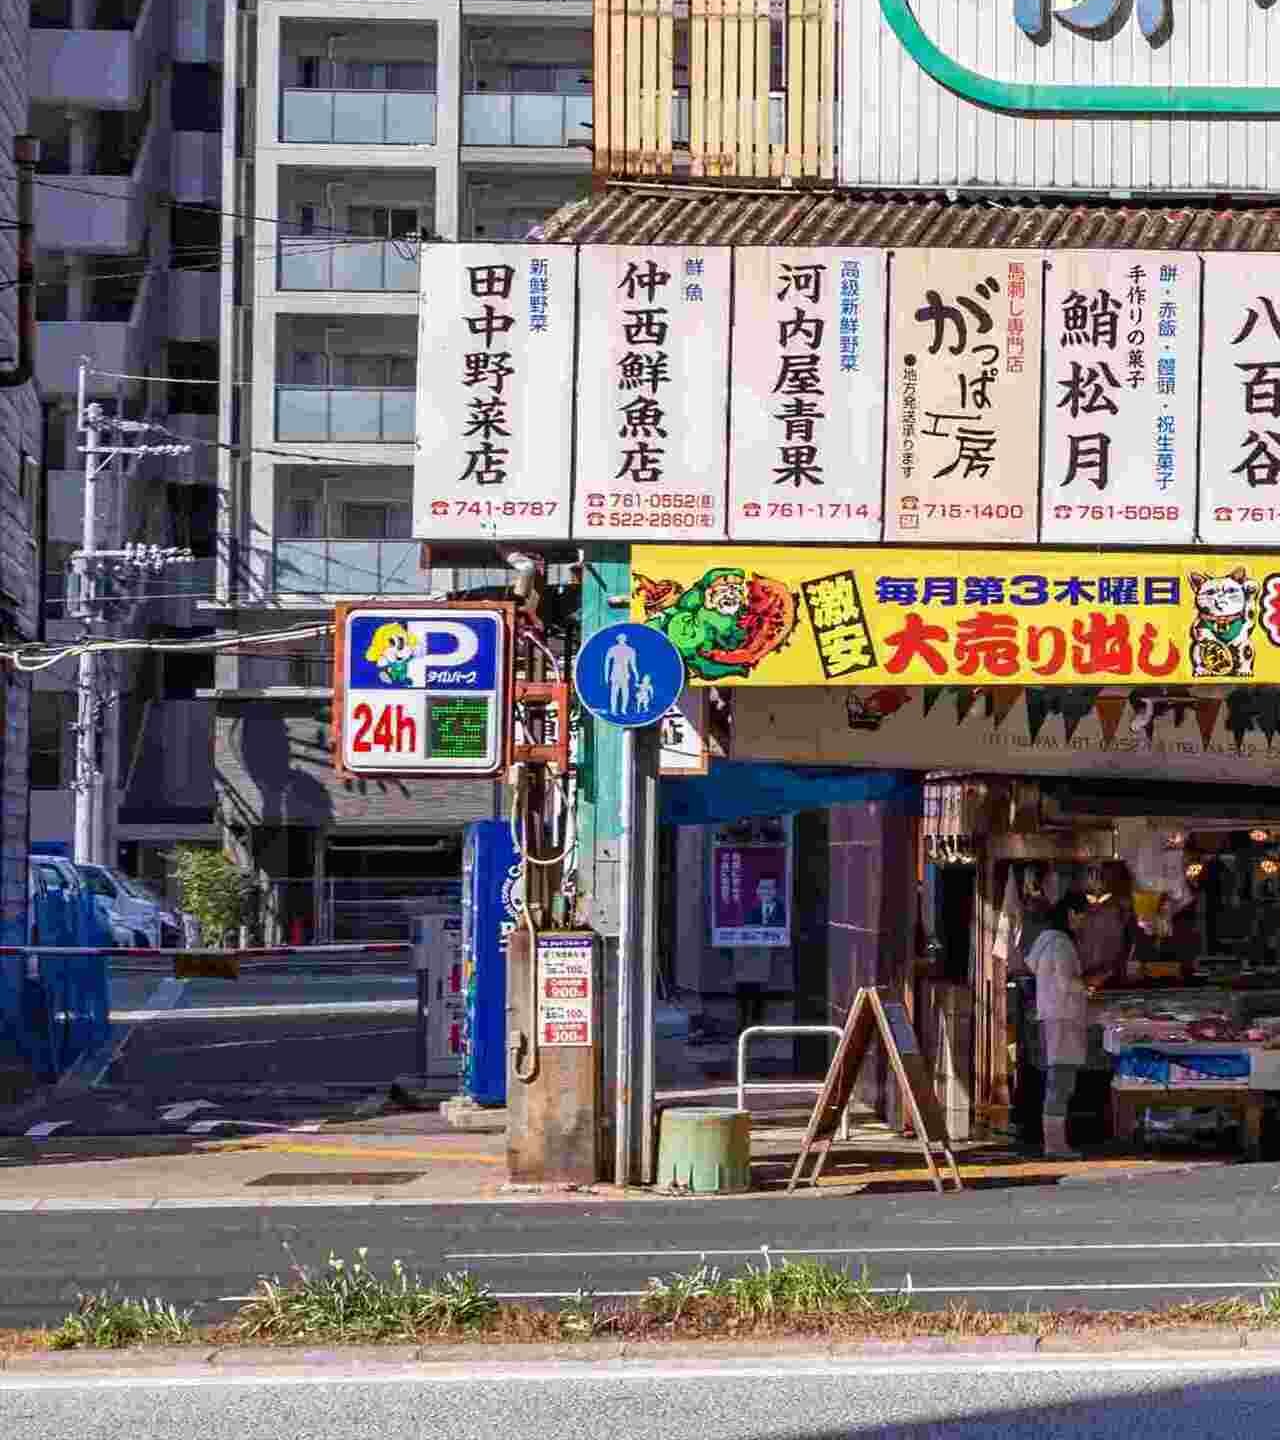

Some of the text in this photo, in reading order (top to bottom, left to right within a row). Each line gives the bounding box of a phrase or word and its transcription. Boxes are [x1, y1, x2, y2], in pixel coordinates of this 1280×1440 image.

[528, 258, 548, 333] 新鮮野菜
[686, 259, 704, 301] 鮮魚
[839, 261, 862, 373] 高級新鮮野菜
[1126, 265, 1147, 388] 手作りの菓子
[459, 264, 516, 486] 田中野菜店
[615, 259, 671, 482] 仲西鮮魚店
[773, 263, 826, 488] 河内屋青果
[1057, 290, 1123, 490] 鮹松月
[454, 501, 557, 518] 741-8787
[767, 502, 869, 518] 761-1714
[925, 504, 1024, 519] 715-1400
[1078, 505, 1179, 521] 761-5058
[408, 621, 480, 688] P
[809, 579, 876, 674] 激安
[882, 611, 1180, 678] 大売り出し
[353, 703, 417, 753] 24h
